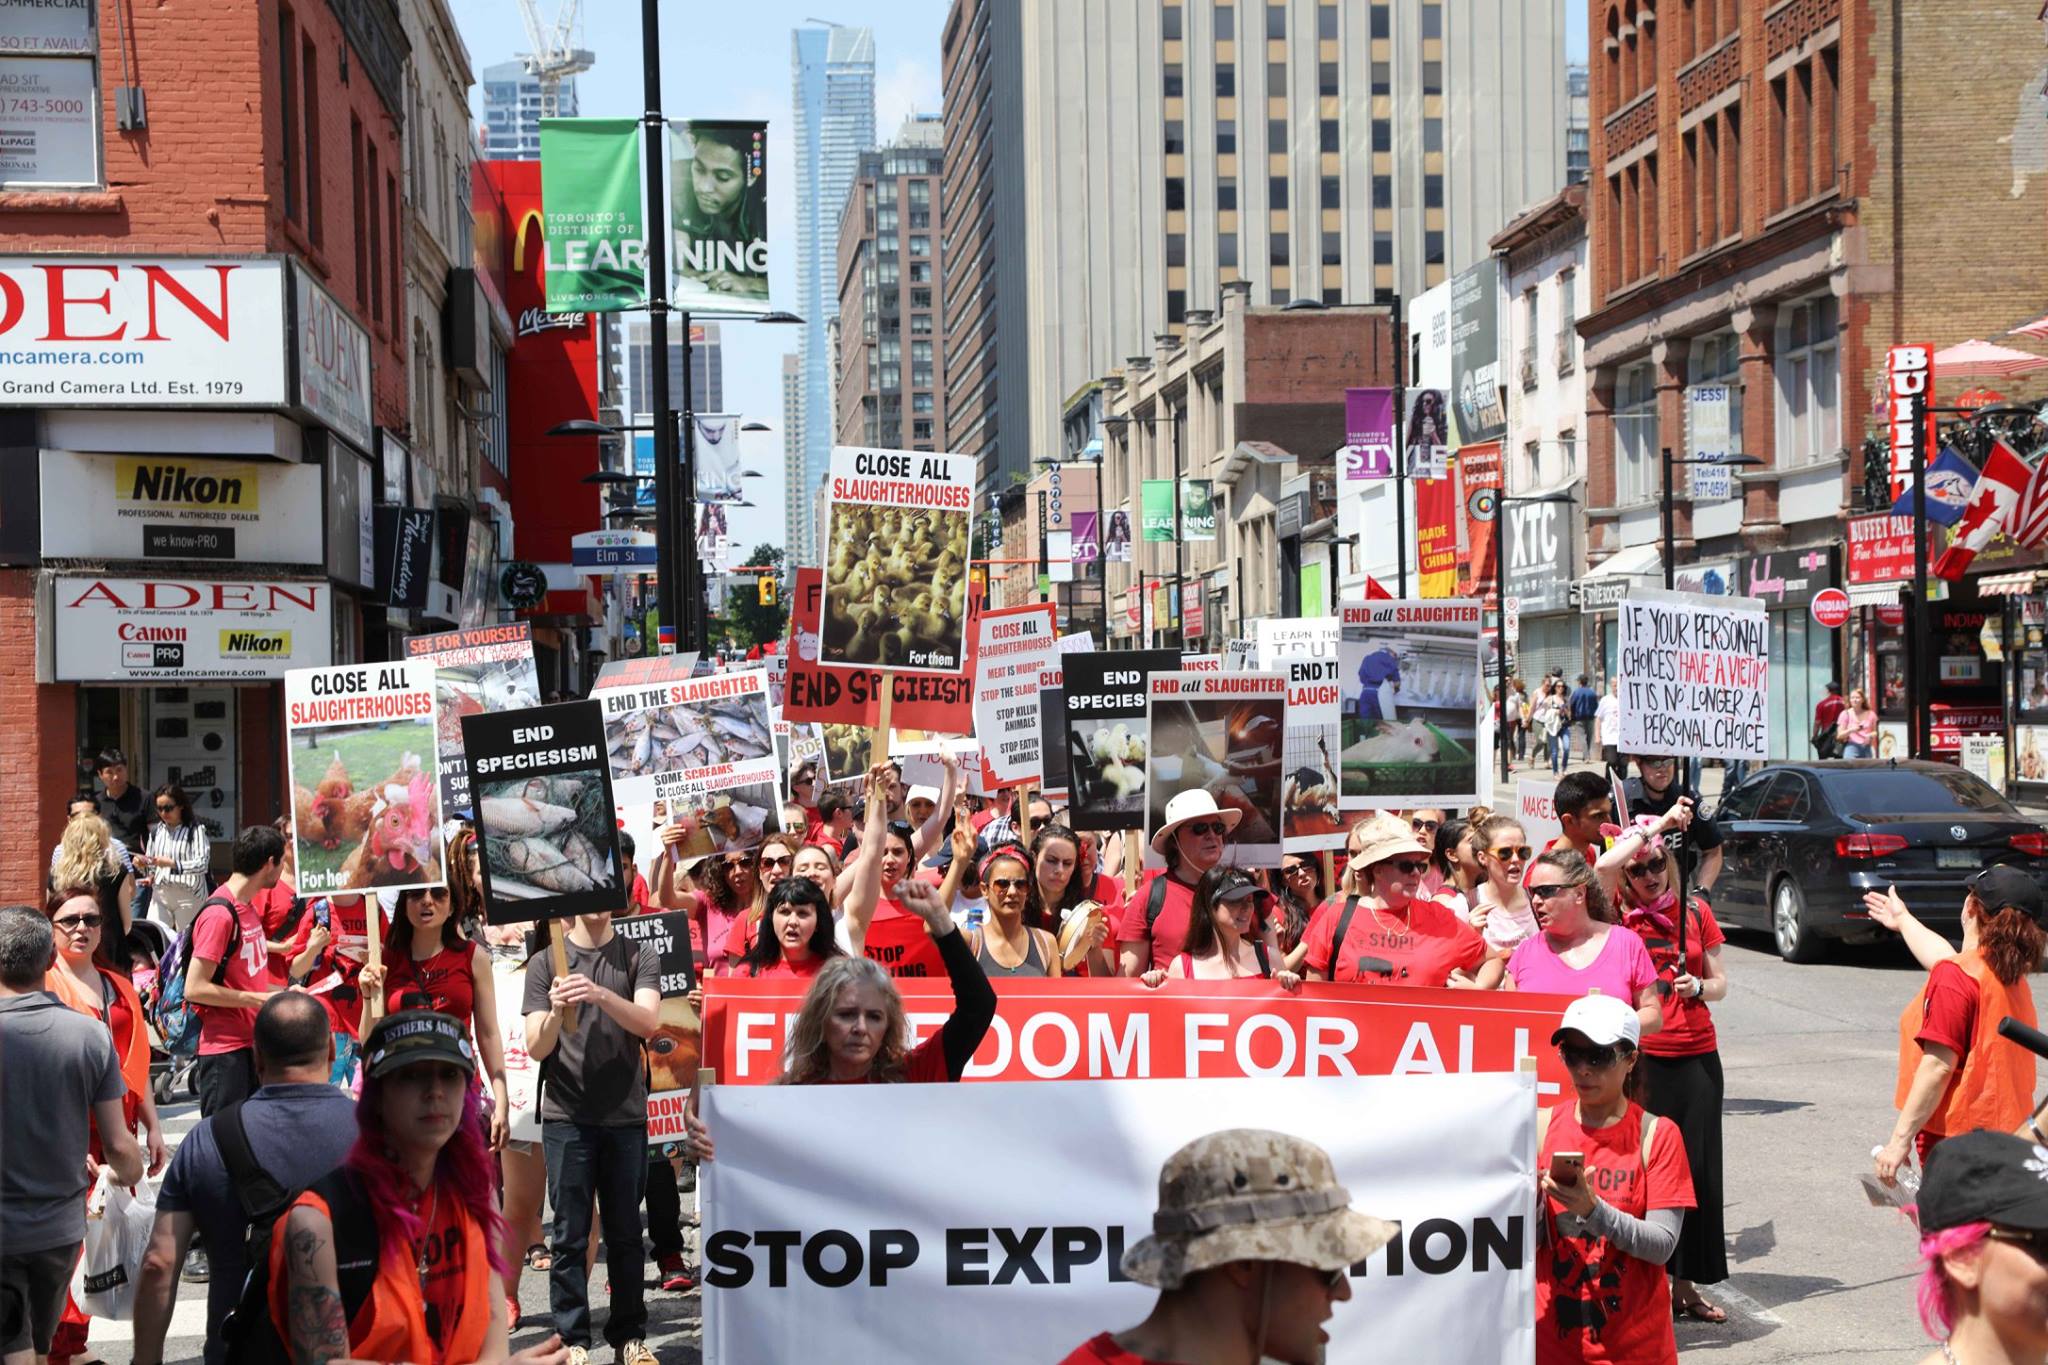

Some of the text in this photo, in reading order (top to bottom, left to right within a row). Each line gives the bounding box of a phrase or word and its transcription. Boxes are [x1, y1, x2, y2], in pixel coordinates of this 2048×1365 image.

[24, 37, 38, 48] FT
[11, 99, 83, 113] 743-5000
[548, 212, 625, 223] TORONTO'S
[549, 224, 634, 235] DISTRICT OF
[3, 382, 243, 396] Grand Camera Ltd. Est. 1979
[855, 453, 951, 481] CLOSE ALL
[132, 465, 242, 504] Nikon
[833, 478, 970, 508] SLAUGHTERHOUSES
[118, 509, 174, 519] PROFESSIONAL
[180, 511, 226, 520] AUTHORIZED
[153, 536, 166, 547] we
[1418, 524, 1447, 542] MADE
[1510, 500, 1558, 569] XTC
[393, 513, 421, 599] Threading
[597, 550, 635, 562] Elm St
[1421, 542, 1432, 555] IN
[1424, 551, 1455, 569] CHINA
[66, 581, 324, 612] ADEN
[1815, 600, 1850, 611] INDIAN
[1344, 606, 1479, 623] END all SLAUGHTER
[118, 623, 283, 652] Canon Nikon
[409, 637, 434, 655] SEE
[435, 634, 461, 650] FOR
[463, 625, 528, 646] YOURSELF
[992, 620, 1038, 640] CLOSE ALL
[1273, 630, 1312, 641] LEARN
[1625, 605, 1768, 657] IF YOUR PERSONAL
[156, 648, 181, 660] PRO
[979, 636, 1052, 658] SLAUGHTERHOUSES
[909, 650, 954, 667] For them
[129, 669, 266, 677] www.adencamera.com
[987, 665, 1015, 680] MEAT IS
[1103, 670, 1141, 686] END
[1291, 662, 1323, 682] END
[1623, 646, 1768, 692] CHOICES HAVE A VICTIM
[311, 667, 410, 696] CLOSE ALL
[790, 671, 971, 708] END SPCIEISM
[1152, 677, 1285, 694] END all SLAUGHTER
[607, 675, 759, 712] END THE SLAUGHTER
[981, 683, 1037, 702] STOP THE SLAUG
[1068, 692, 1147, 710] SPECIES
[1288, 686, 1338, 707] LAUGH
[1628, 682, 1641, 710] IT
[1645, 683, 1658, 711] IS
[1692, 686, 1743, 717] LONGER
[1748, 691, 1765, 721] A
[291, 691, 432, 724] SLAUGHTERHOUSES
[996, 703, 1037, 721] STOP KILLIN
[512, 724, 555, 744] END
[1004, 717, 1036, 732] ANIMALS
[1643, 713, 1765, 754] PERSONAL CHOICE
[1000, 737, 1039, 754] STOP EATIN
[476, 745, 598, 774] SPECIESISM
[1008, 750, 1039, 766] ANIMALS
[654, 764, 734, 786] SOME SCREAMS
[705, 770, 775, 790] SLAUGHTERHOUSES
[667, 782, 706, 798] CLOSE ALL
[1522, 796, 1548, 819] MAKE
[301, 868, 351, 889] For her
[864, 945, 905, 963] STOP
[384, 1020, 460, 1041] ESTHERS ARMY
[1184, 1012, 1360, 1079] FOR
[647, 1096, 688, 1117] DON'
[647, 1116, 688, 1137] WAL
[703, 1228, 921, 1289] STOP
